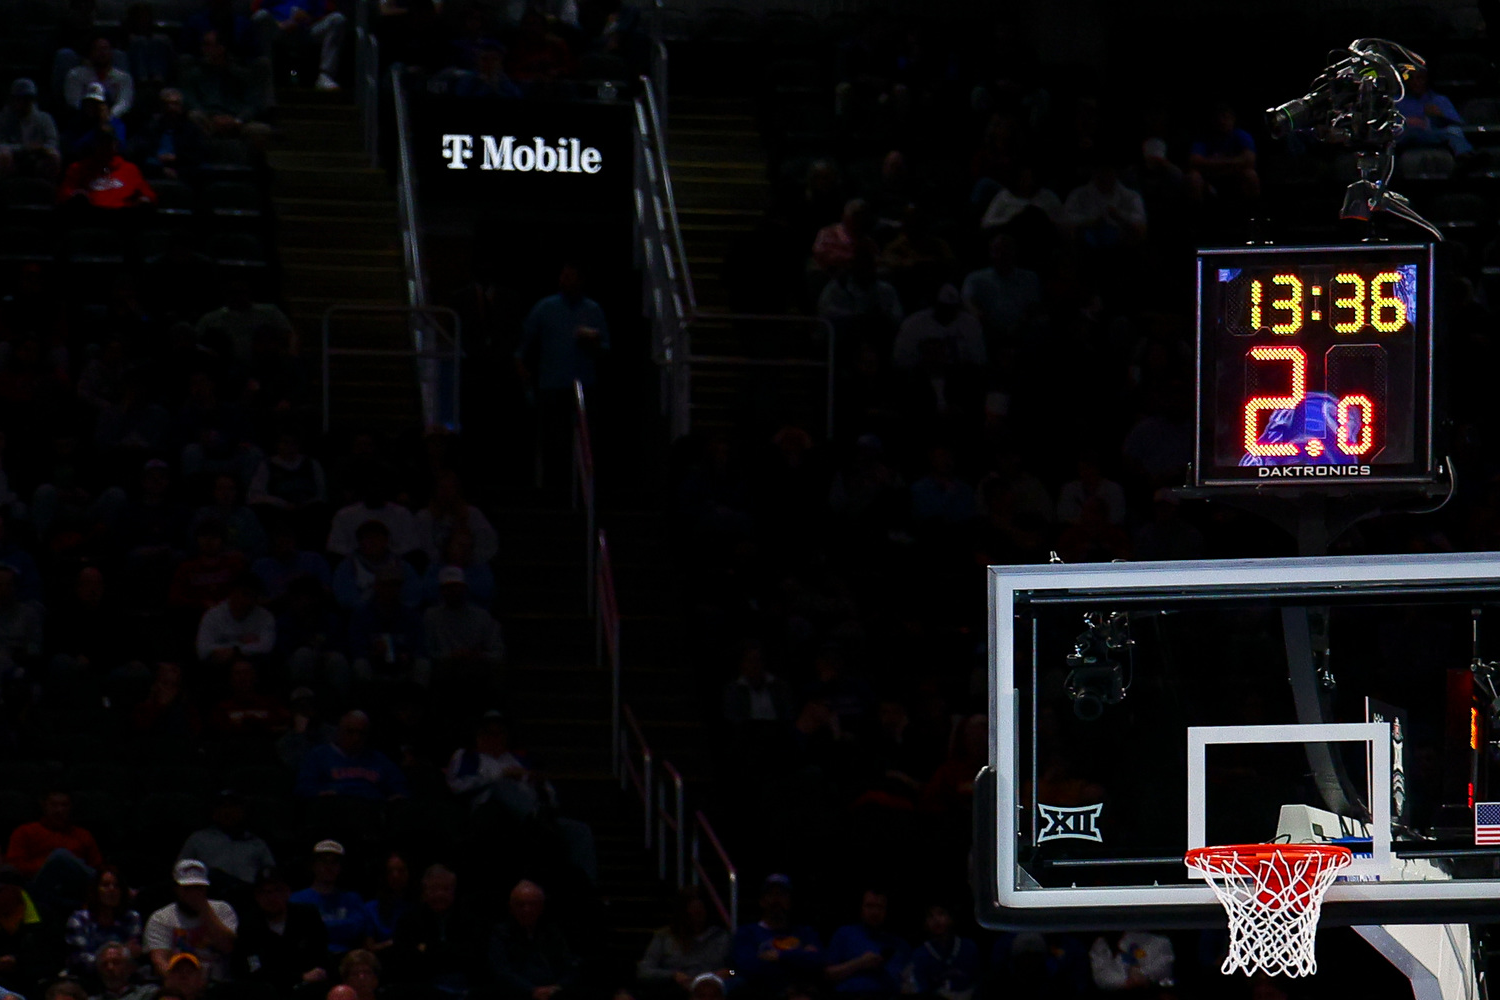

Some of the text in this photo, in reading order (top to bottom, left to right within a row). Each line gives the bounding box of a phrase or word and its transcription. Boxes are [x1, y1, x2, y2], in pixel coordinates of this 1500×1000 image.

[479, 134, 603, 175] Mobile
[1250, 272, 1407, 334] 13:36
[1257, 465, 1372, 478] DAKTRONICS
